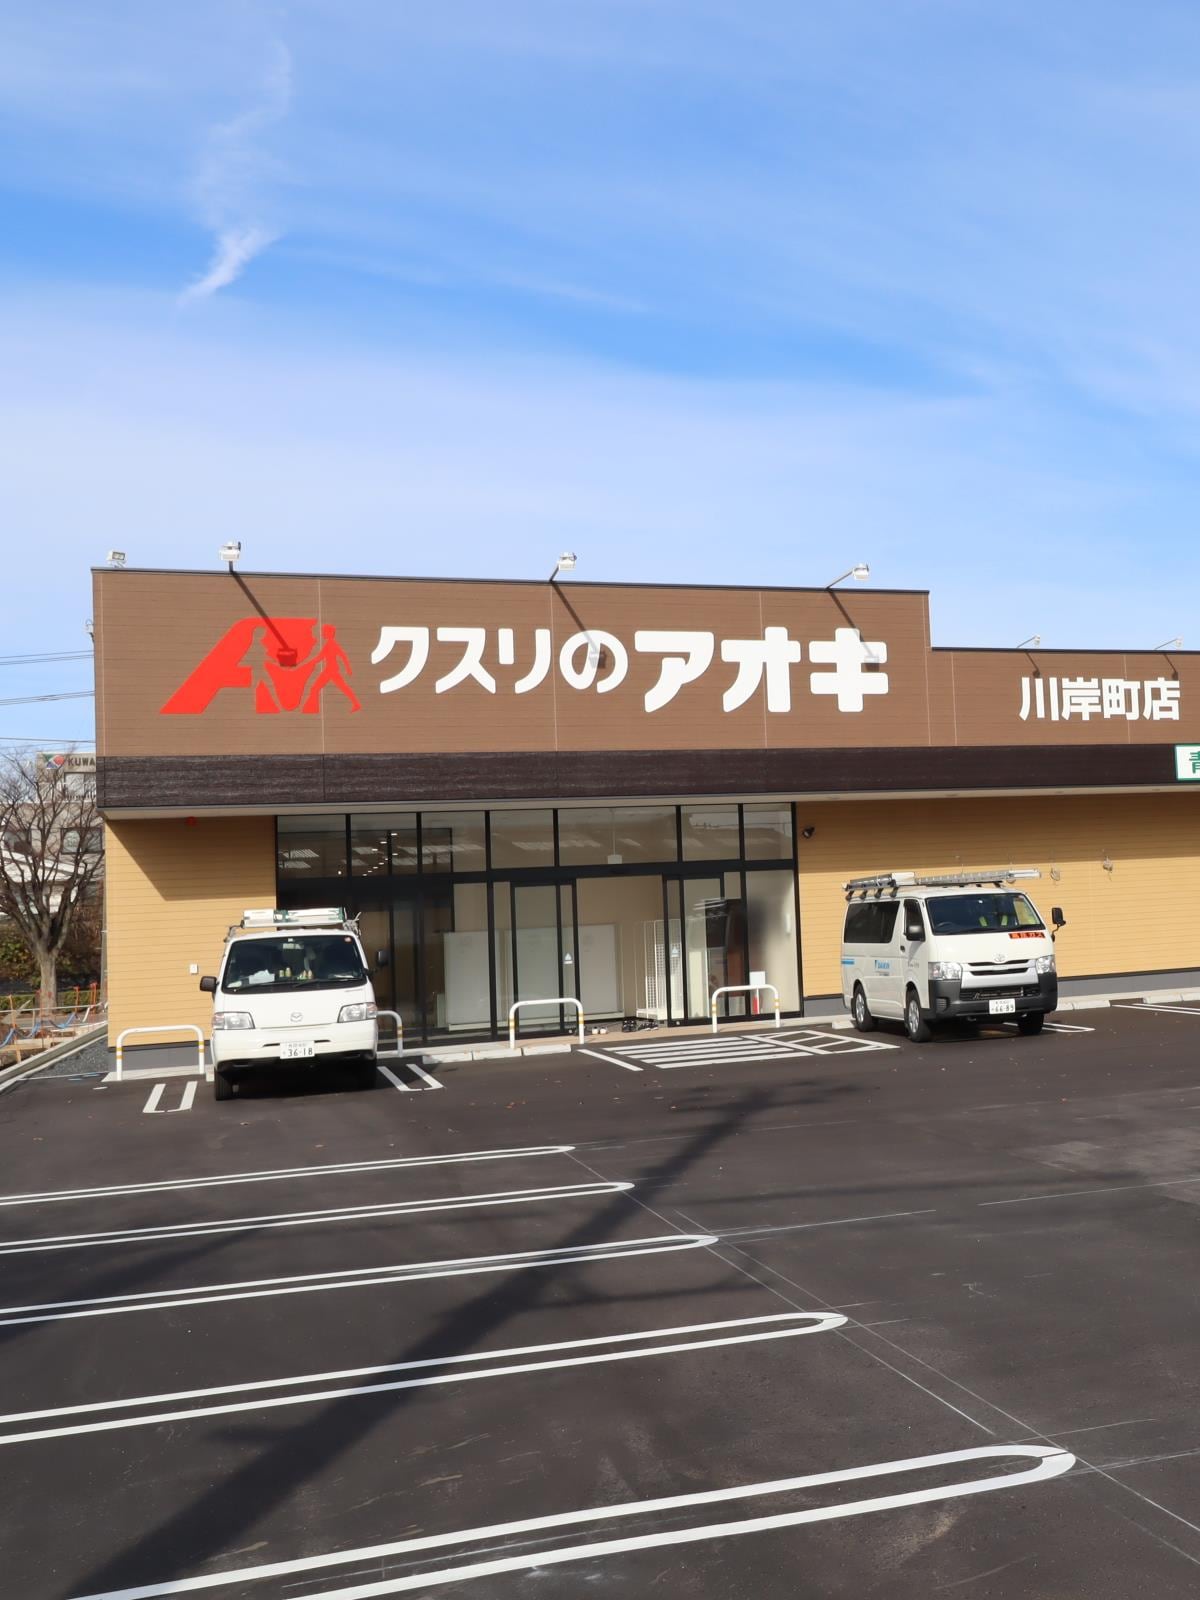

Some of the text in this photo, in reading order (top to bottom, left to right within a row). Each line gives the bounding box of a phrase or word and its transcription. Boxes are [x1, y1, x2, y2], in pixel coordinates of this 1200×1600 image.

[371, 626, 889, 713] クスリのアオキ
[1019, 677, 1181, 721] 川岸町店
